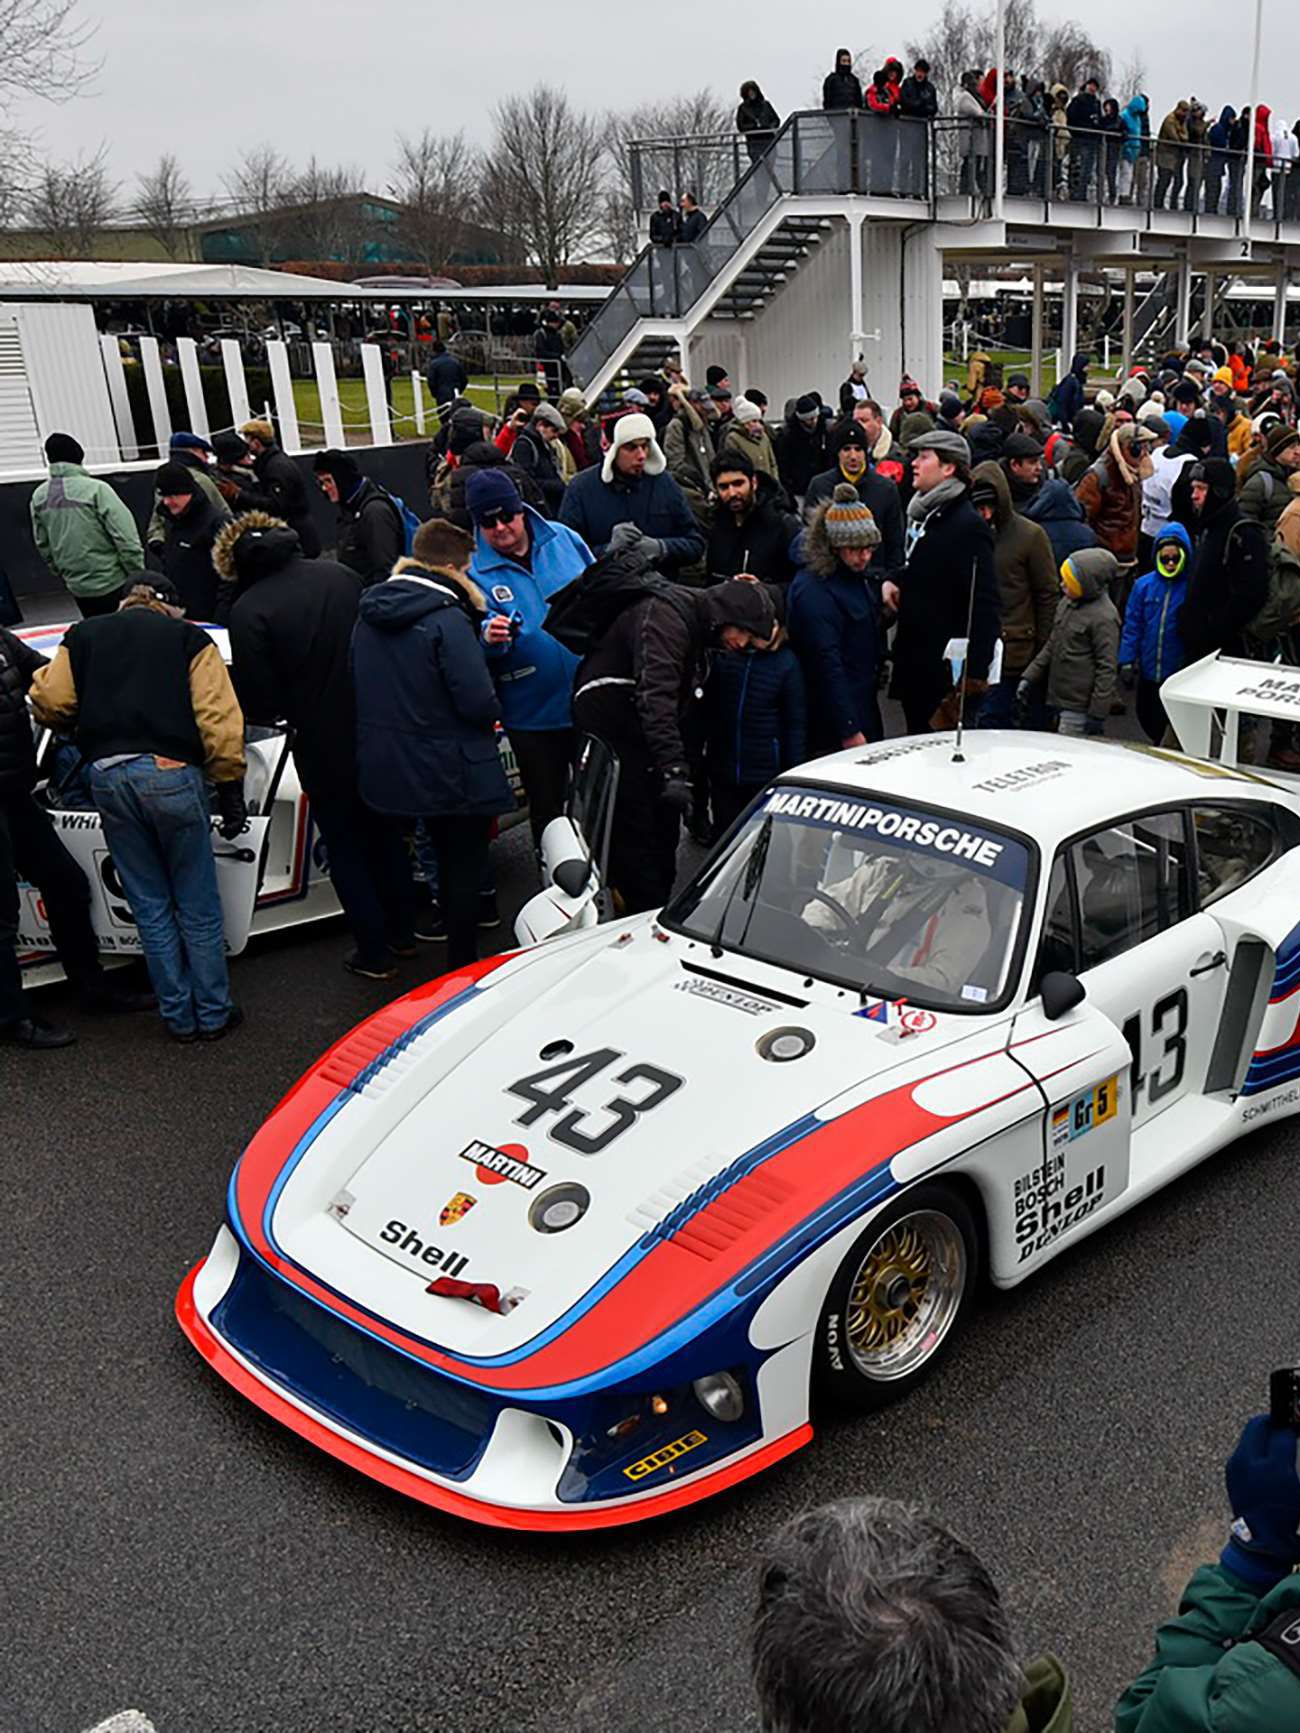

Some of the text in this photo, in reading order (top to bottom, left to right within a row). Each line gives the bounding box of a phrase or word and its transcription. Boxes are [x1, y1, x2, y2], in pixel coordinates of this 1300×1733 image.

[1240, 242, 1249, 257] 2
[503, 1046, 687, 1155] 43
[1075, 1099, 1094, 1130] Gr
[1098, 1086, 1108, 1117] 5
[463, 1143, 542, 1188] MARTINI
[1015, 1152, 1064, 1198] BILSTEIN
[1015, 1172, 1064, 1218] BOSCH
[1016, 1165, 1104, 1244] Shell
[379, 1220, 470, 1278] Shell
[1017, 1192, 1104, 1264] DUNLOP
[827, 1314, 844, 1371] AVON
